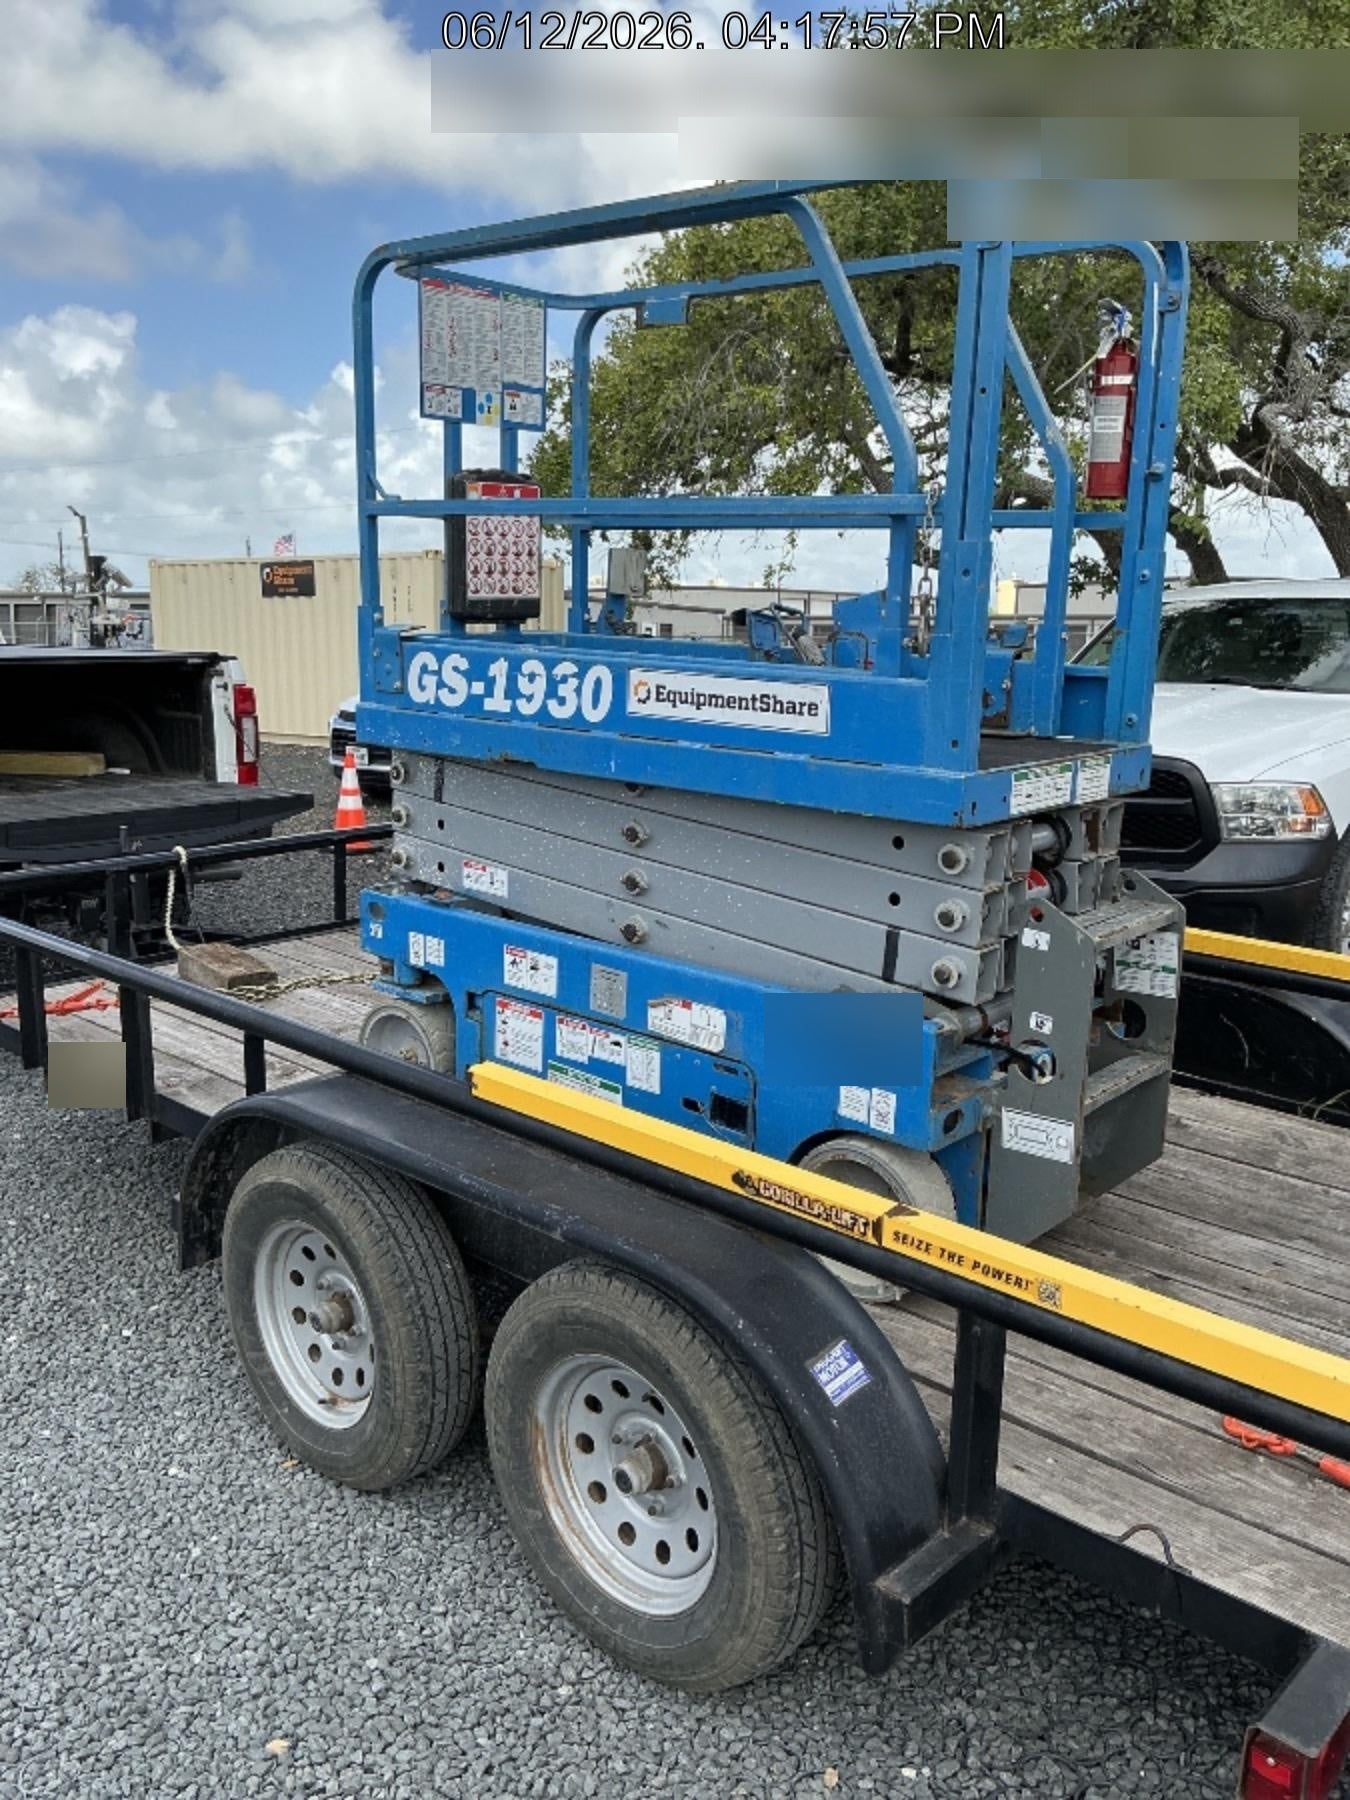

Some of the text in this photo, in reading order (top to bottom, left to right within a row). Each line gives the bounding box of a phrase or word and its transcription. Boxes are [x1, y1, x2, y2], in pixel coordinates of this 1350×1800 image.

[407, 651, 613, 723] GS-1930
[655, 684, 819, 717] EquipmentShare
[893, 1230, 933, 1255] SEIZE
[939, 1247, 965, 1267] THE
